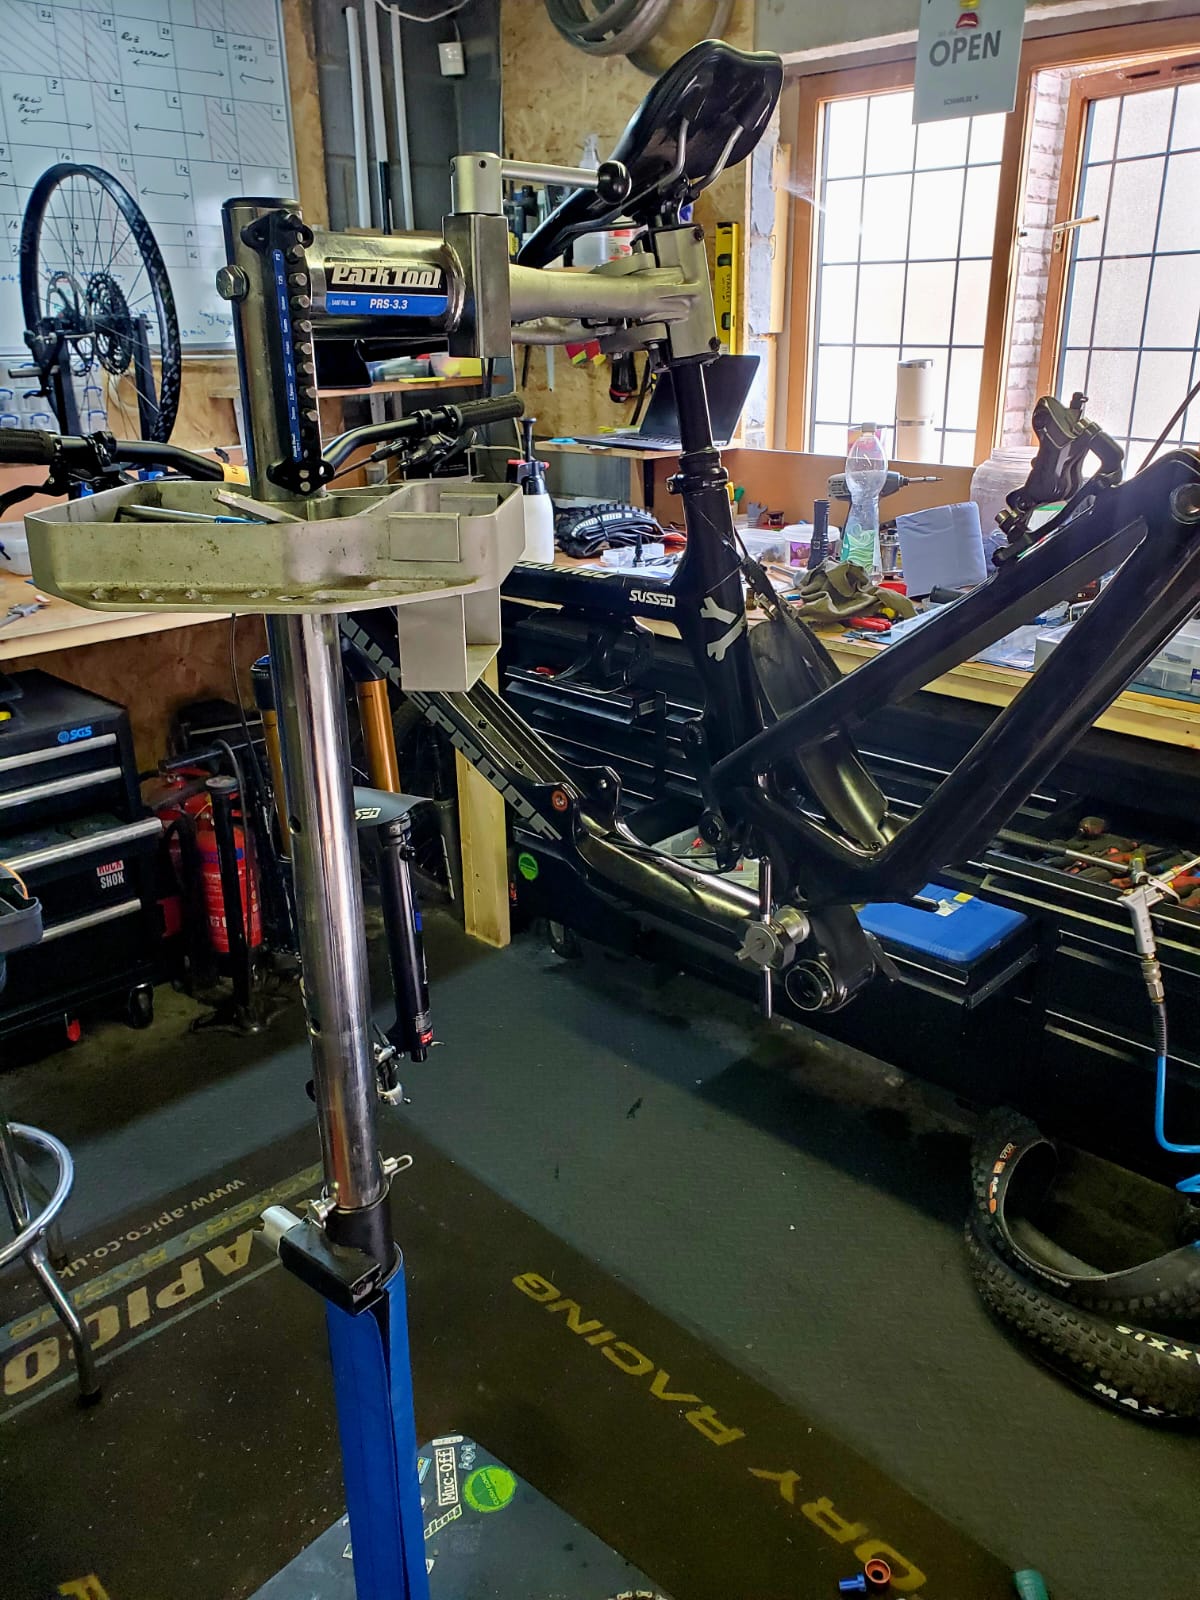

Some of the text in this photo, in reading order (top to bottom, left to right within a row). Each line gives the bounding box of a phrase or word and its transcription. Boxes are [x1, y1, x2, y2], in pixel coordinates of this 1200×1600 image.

[929, 30, 1001, 67] OPEN
[369, 298, 408, 310] PRS-3.3
[629, 590, 676, 608] SUSSED
[70, 726, 92, 741] SGS
[354, 807, 382, 820] SED
[100, 870, 125, 889] SHOX
[56, 1179, 246, 1279] www.apico.co.uk
[4, 1229, 255, 1396] APICO
[512, 1272, 926, 1591] ORY RACING
[439, 1448, 456, 1502] Muc-Off
